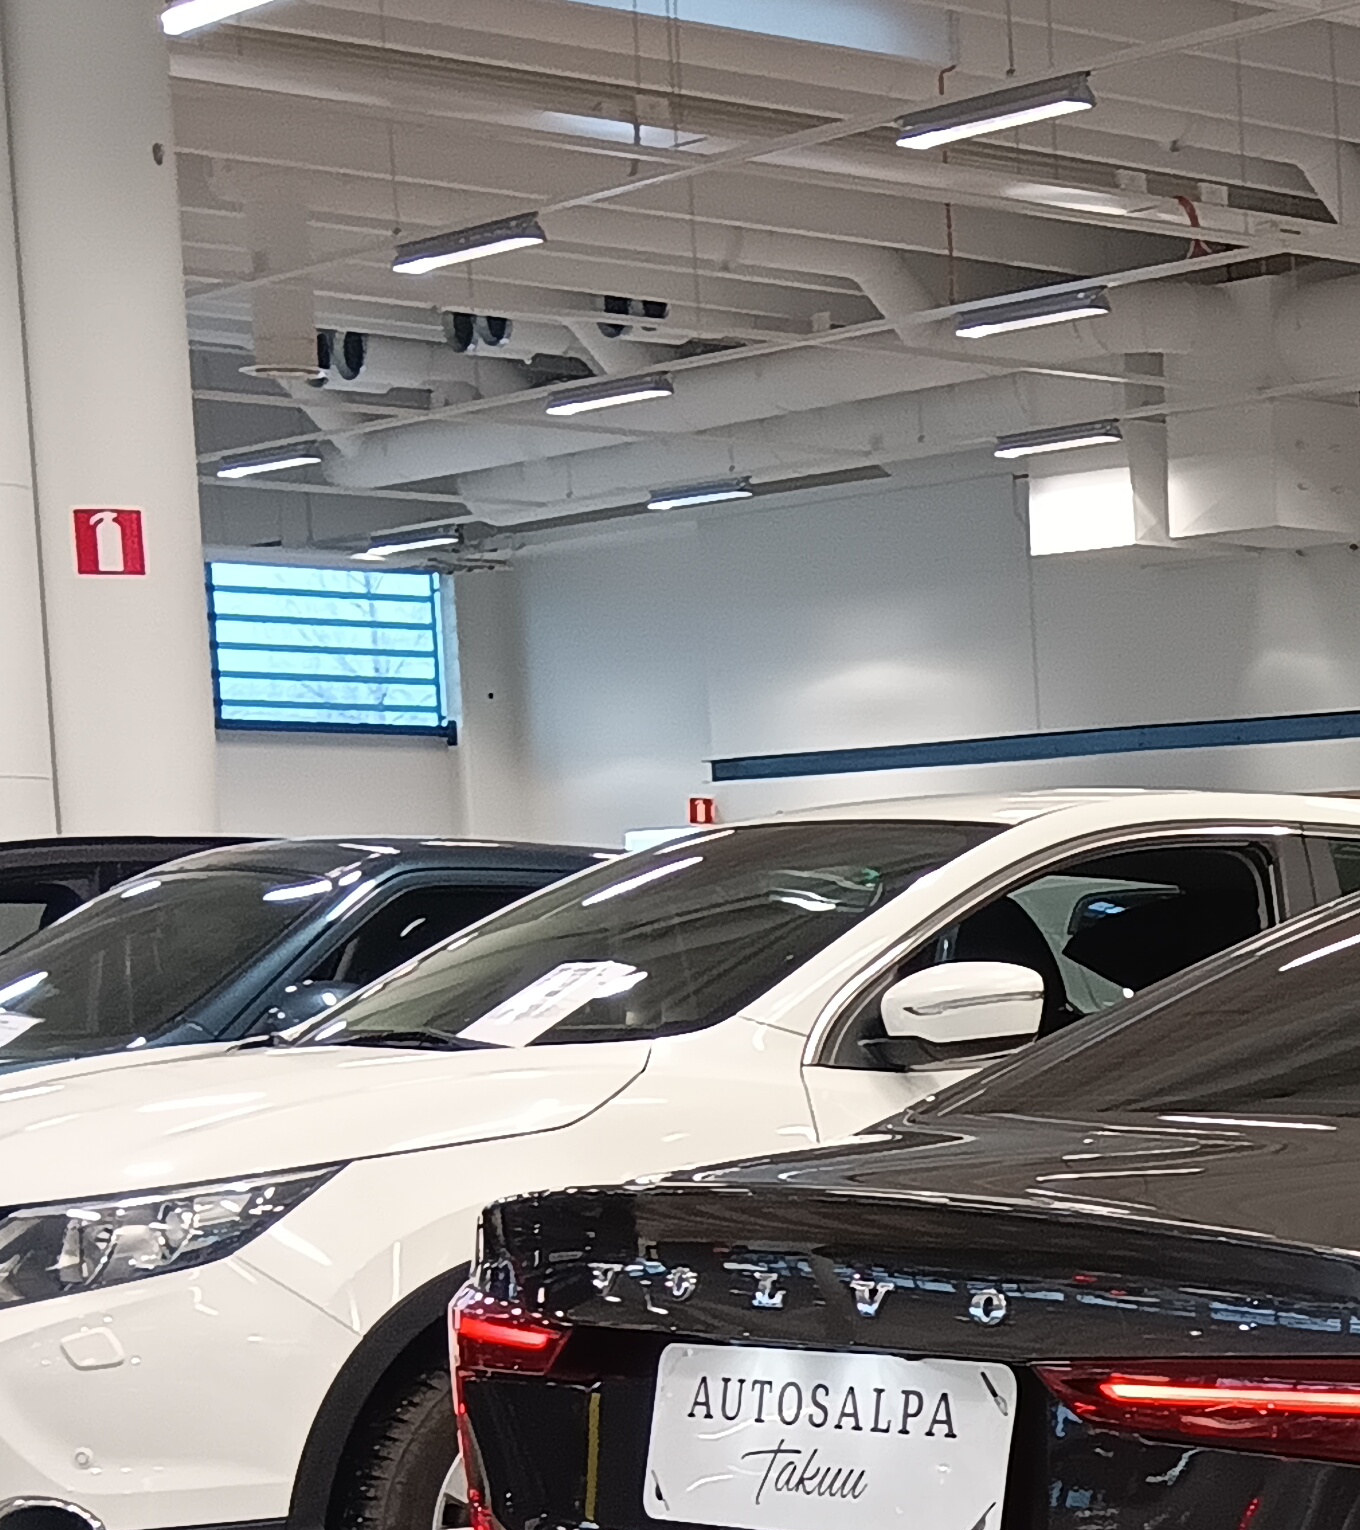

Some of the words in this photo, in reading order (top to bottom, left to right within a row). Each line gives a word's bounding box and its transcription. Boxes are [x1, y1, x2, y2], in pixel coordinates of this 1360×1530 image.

[588, 1262, 1006, 1326] VOLVO
[687, 1376, 957, 1438] AUTOSALPA
[741, 1439, 867, 1505] Takuu
